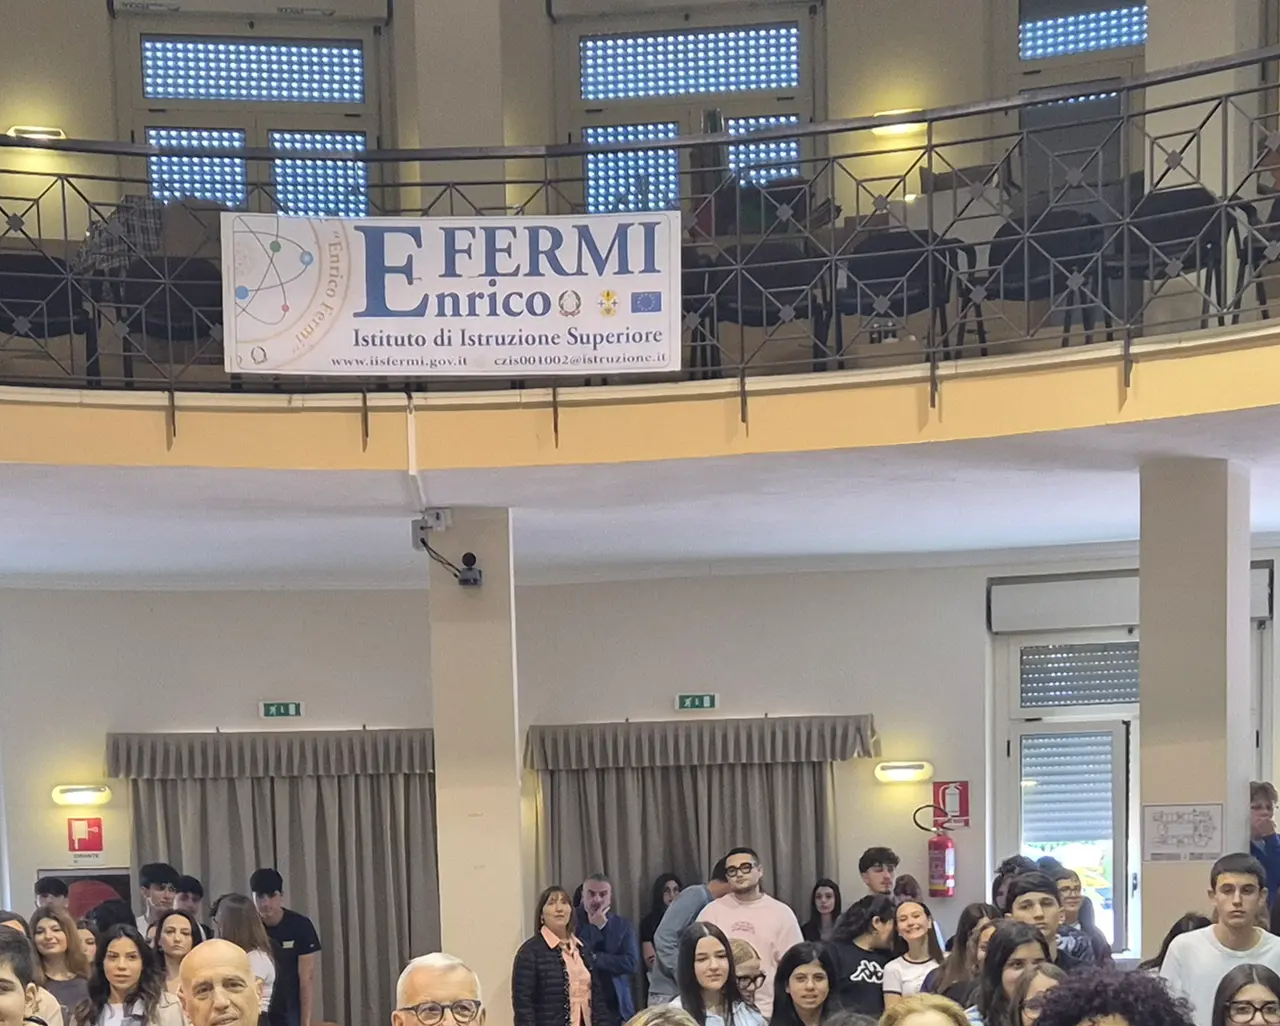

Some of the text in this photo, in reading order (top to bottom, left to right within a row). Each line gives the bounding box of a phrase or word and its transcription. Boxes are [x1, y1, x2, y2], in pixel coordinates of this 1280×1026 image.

[438, 221, 662, 278] FERMI
[353, 326, 663, 350] Istituto di Istruzione Superiore
[331, 356, 467, 368] www.iisfermi.gov.it
